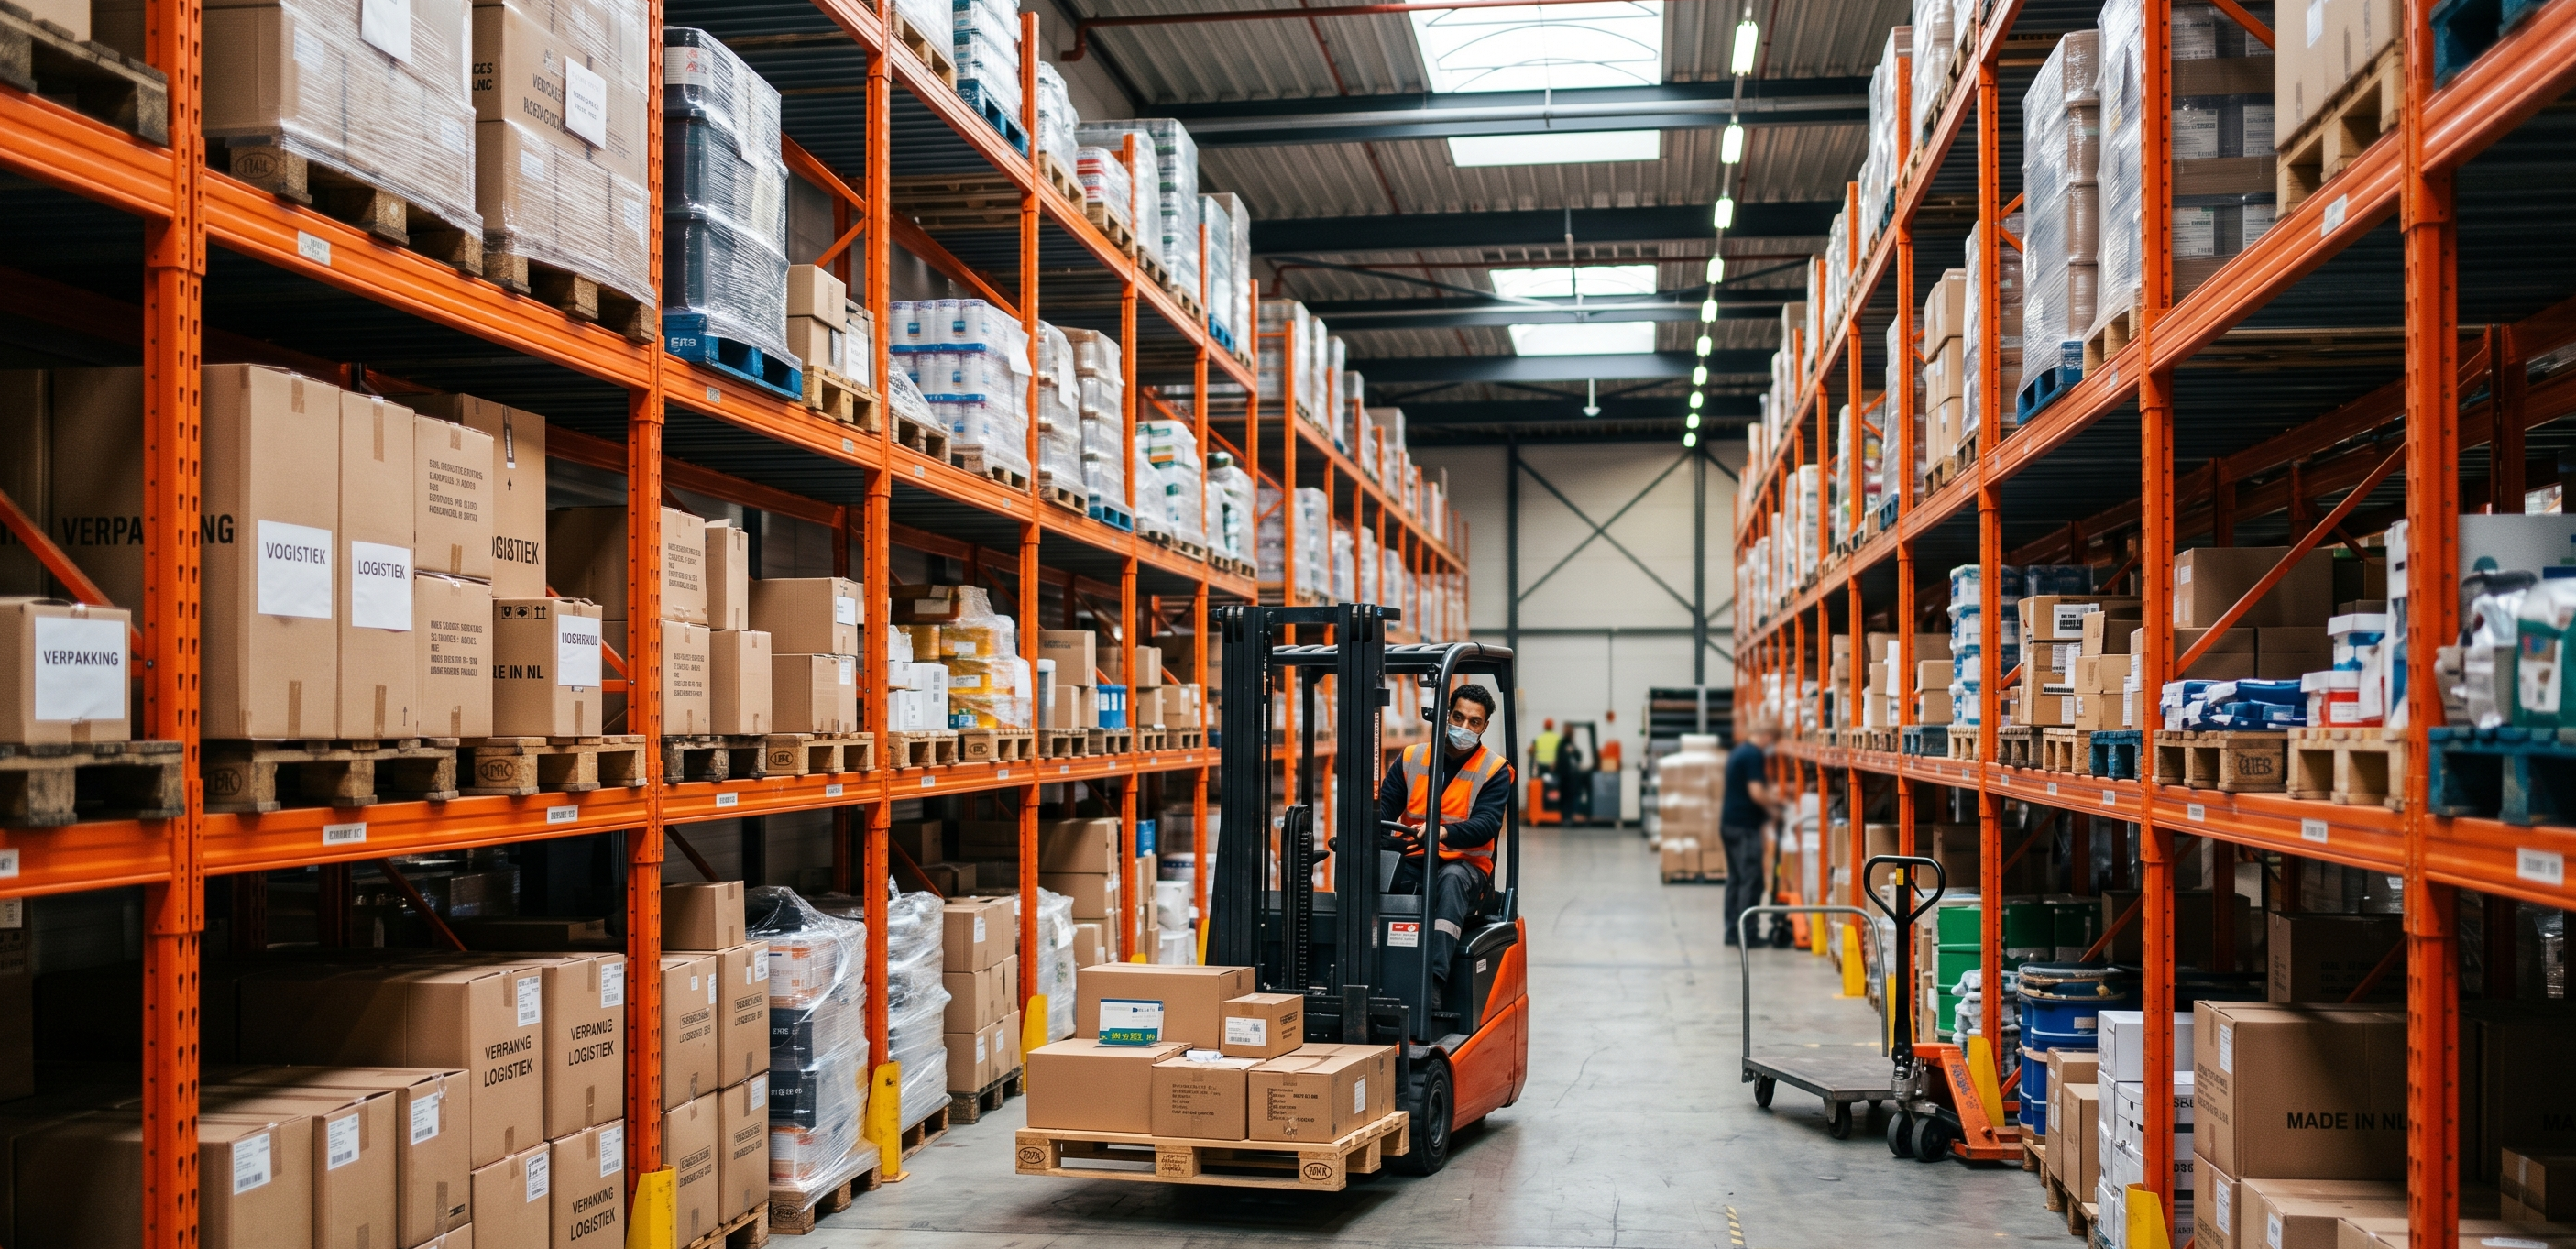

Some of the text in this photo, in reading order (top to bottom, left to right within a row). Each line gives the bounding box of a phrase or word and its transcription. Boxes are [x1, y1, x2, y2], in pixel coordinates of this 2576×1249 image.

[62, 514, 234, 545] VERPANG
[266, 542, 326, 564] VOGISTIEK
[358, 560, 406, 579] LOGISTIEK
[43, 650, 119, 666] VERPAKKING
[510, 664, 522, 679] IN
[527, 664, 544, 679] NL
[569, 1040, 614, 1066] LOGISTIEK
[484, 1057, 532, 1088] LOGISTIEK
[2286, 1112, 2348, 1130] MADE
[2355, 1112, 2375, 1130] IN
[570, 1206, 616, 1241] LOGISTIEK
